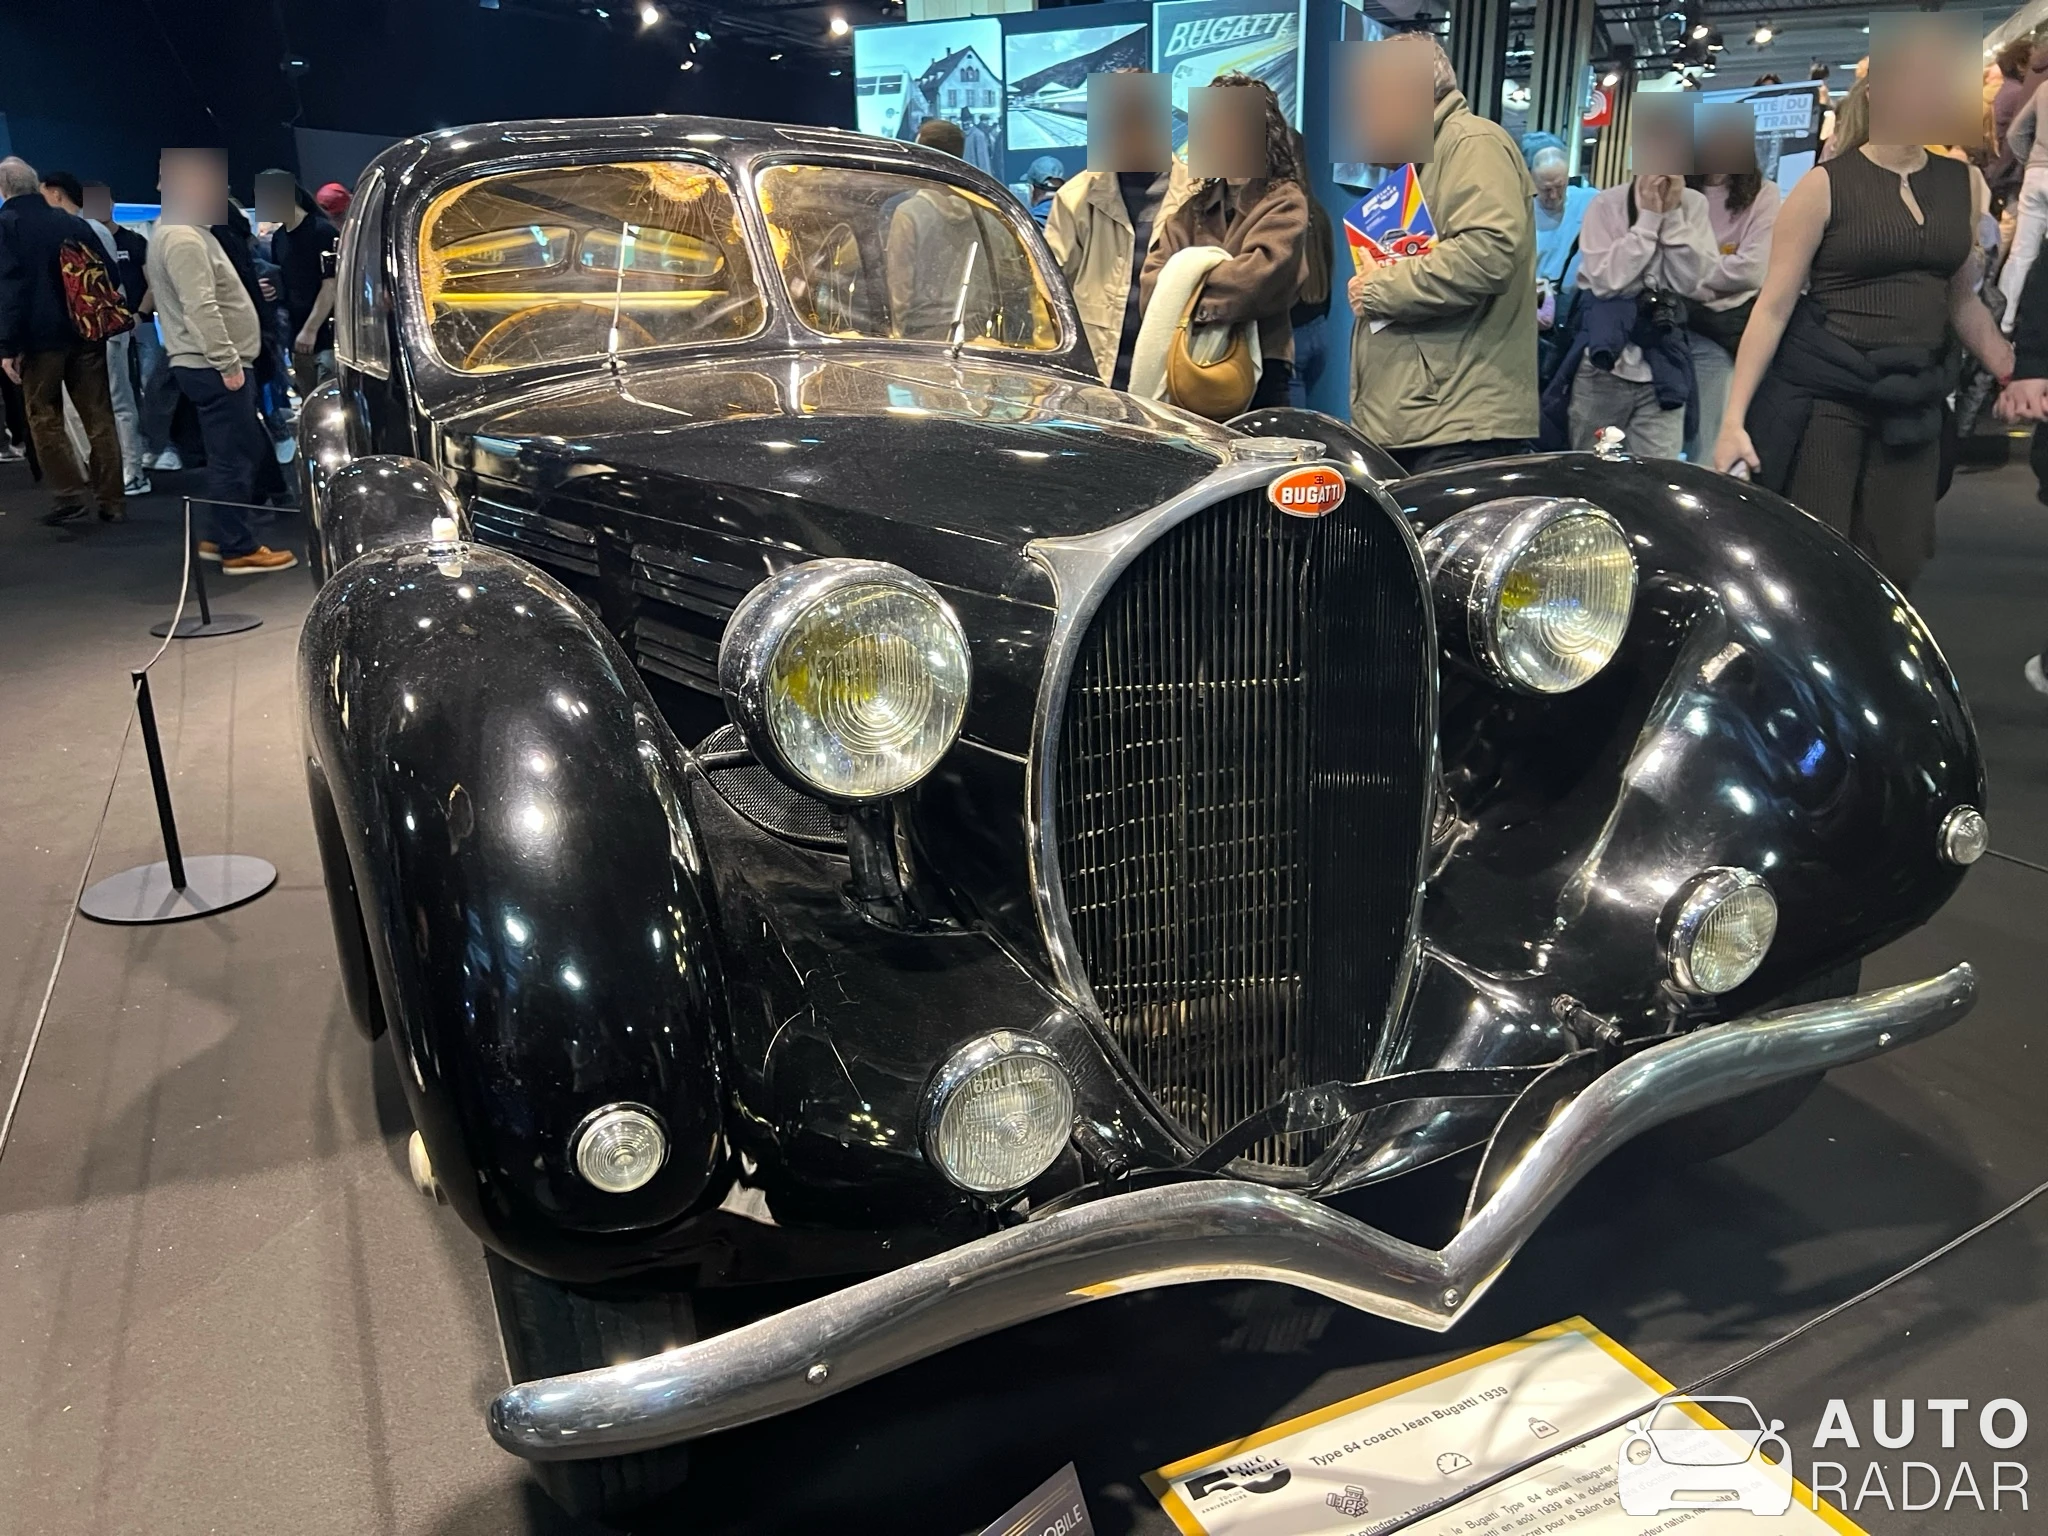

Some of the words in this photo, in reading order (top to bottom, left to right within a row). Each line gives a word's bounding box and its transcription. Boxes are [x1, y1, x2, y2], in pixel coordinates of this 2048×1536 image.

[1164, 12, 1297, 57] BUGATTI
[1764, 114, 1806, 128] TRAIN
[1786, 98, 1807, 110] DU
[1281, 484, 1340, 505] BUGATTI
[1309, 1450, 1343, 1467] Type
[1343, 1442, 1361, 1454] 64
[1363, 1426, 1402, 1447] coach
[1402, 1415, 1433, 1432] Jean
[1431, 1397, 1478, 1421] Bugatti
[1478, 1386, 1509, 1402] 1939
[1465, 1510, 1500, 1529] Bugatti
[1500, 1502, 1525, 1514] Type
[1527, 1493, 1542, 1504] 64
[1545, 1481, 1572, 1497] devait
[1575, 1464, 1614, 1484] inaugurer
[1501, 1523, 1514, 1533] en
[1516, 1513, 1538, 1527] août
[1537, 1501, 1563, 1516] 1939
[1565, 1496, 1577, 1506] et
[1577, 1492, 1587, 1502] le
[1545, 1518, 1567, 1534] pour
[1566, 1513, 1577, 1523] le
[1575, 1503, 1602, 1518] Salon
[1602, 1496, 1617, 1507] de
[1664, 1510, 1696, 1530] nature,
